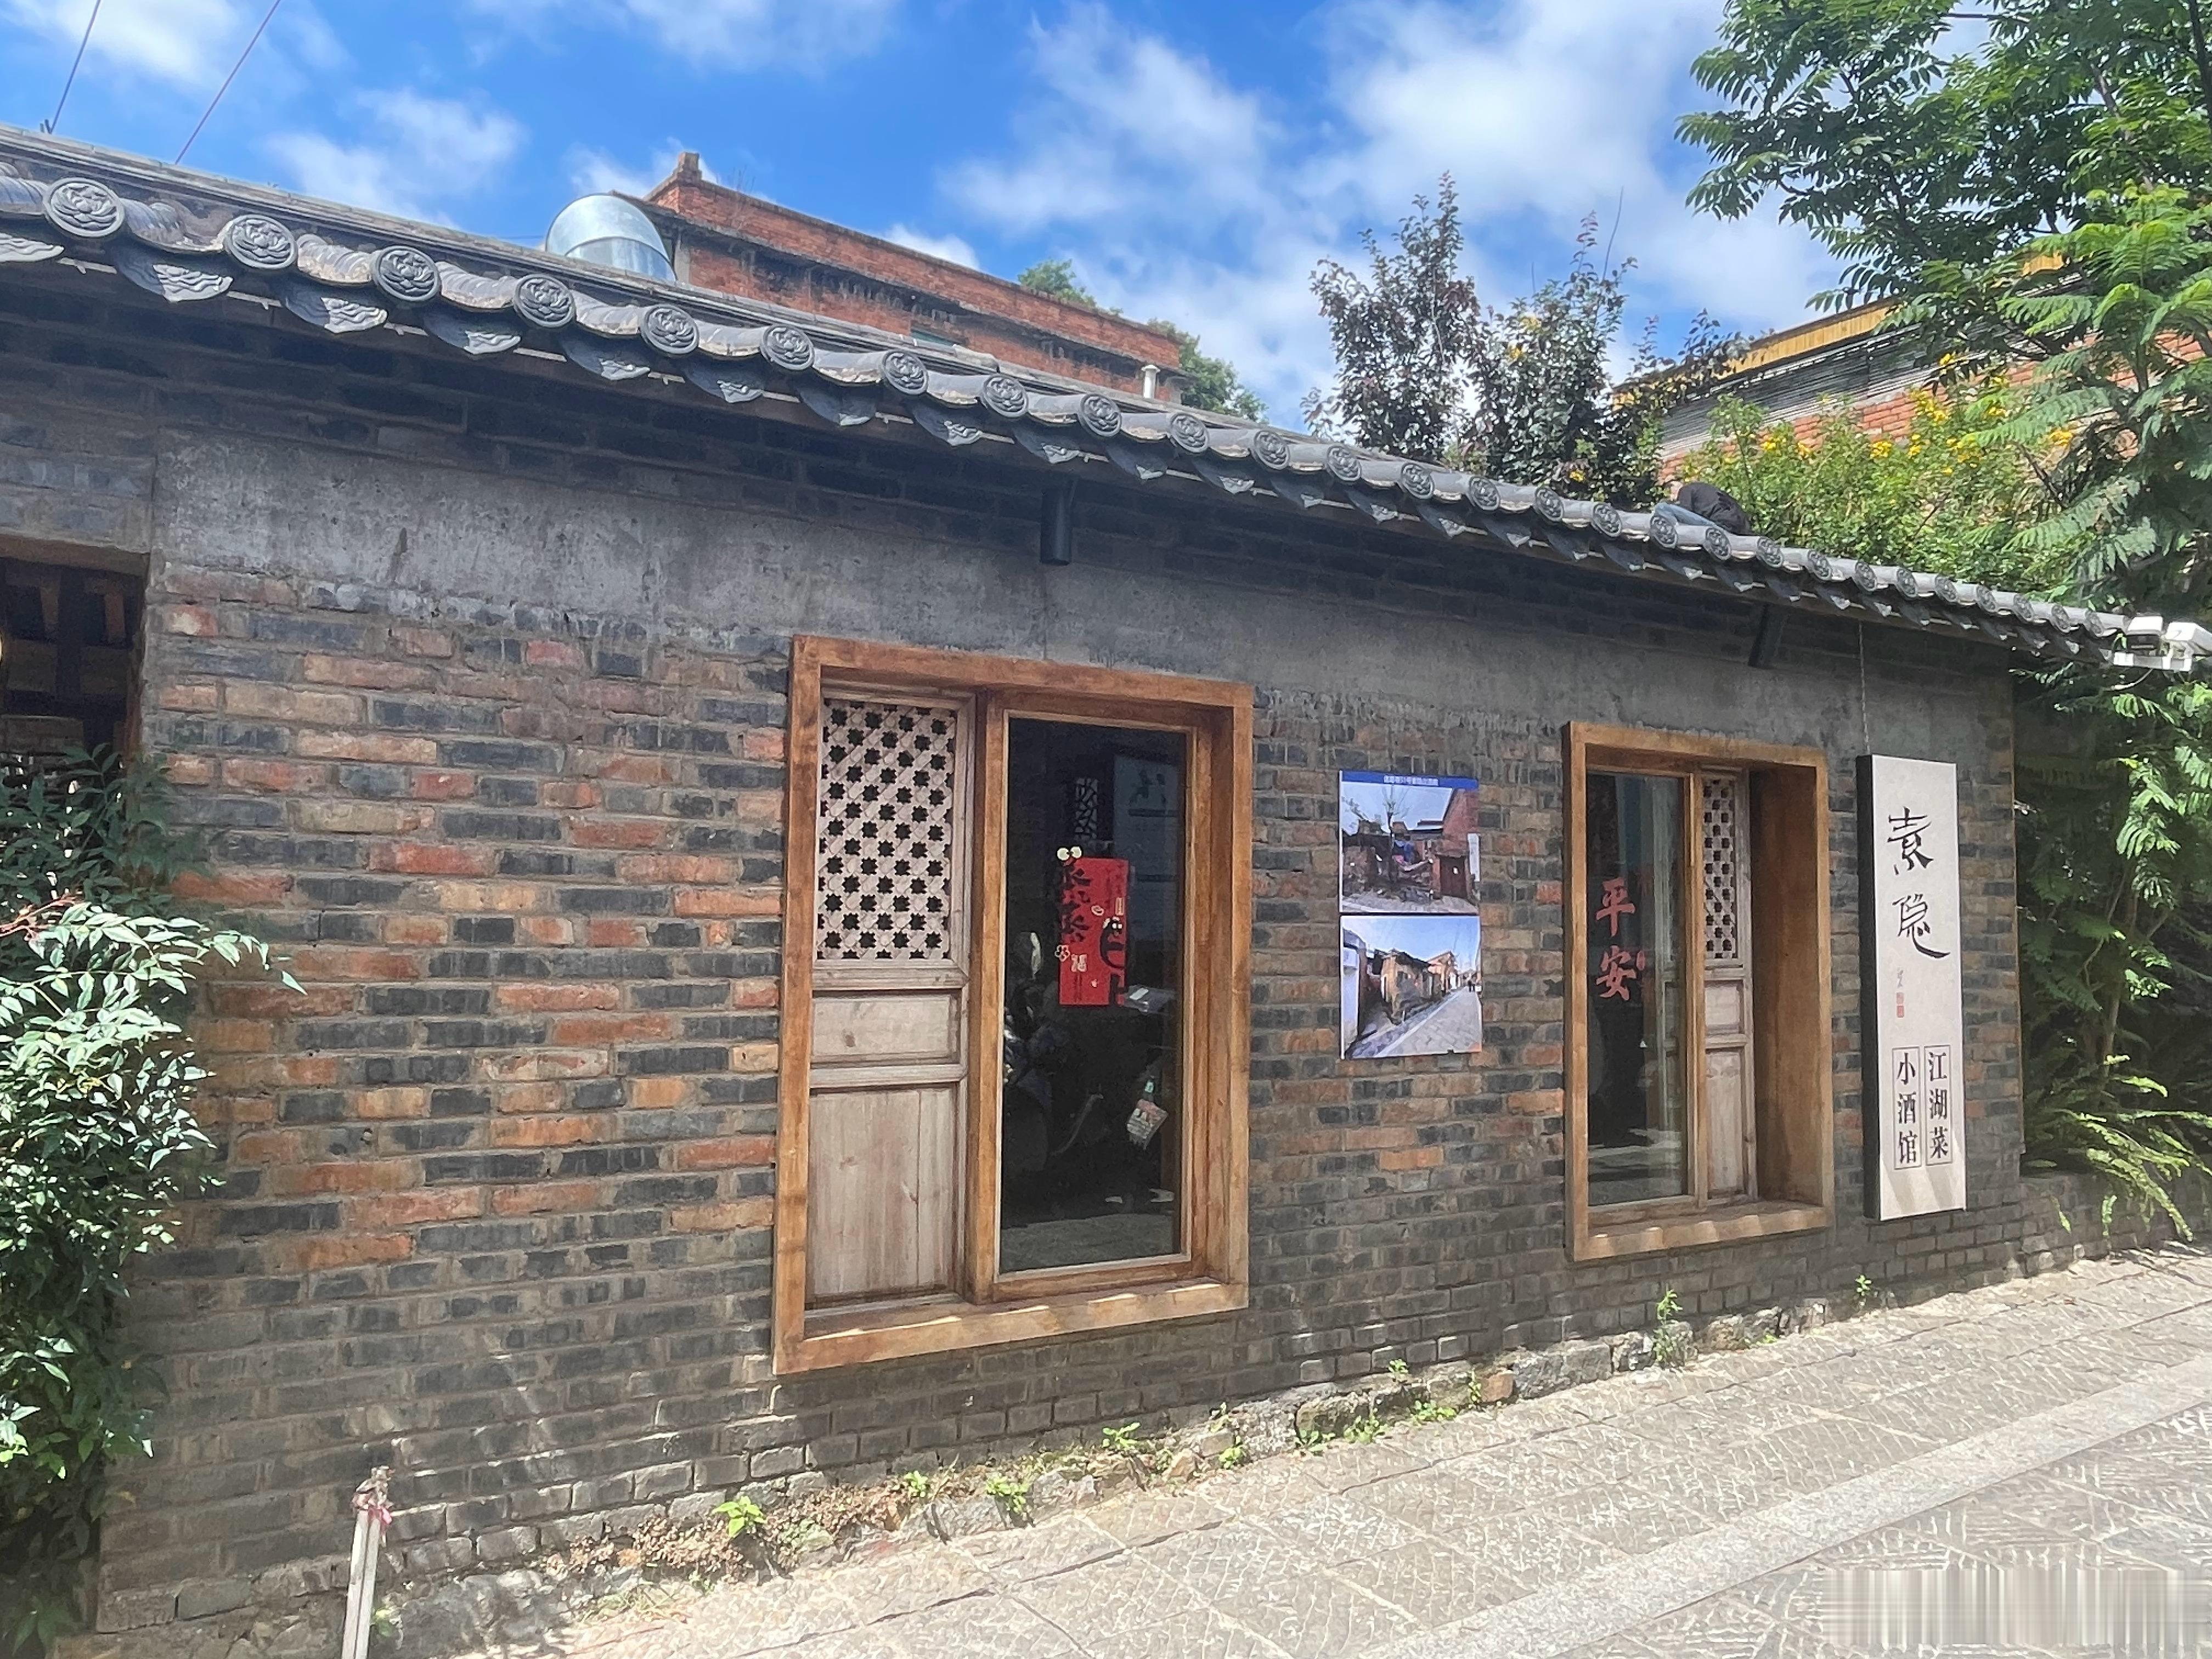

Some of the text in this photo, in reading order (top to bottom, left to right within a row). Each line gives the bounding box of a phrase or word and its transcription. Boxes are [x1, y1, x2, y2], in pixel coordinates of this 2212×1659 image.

[1595, 878, 1637, 1001] 平安
[1897, 1052, 1918, 1164] 小酒馆
[1928, 1051, 1949, 1159] 江湖菜
